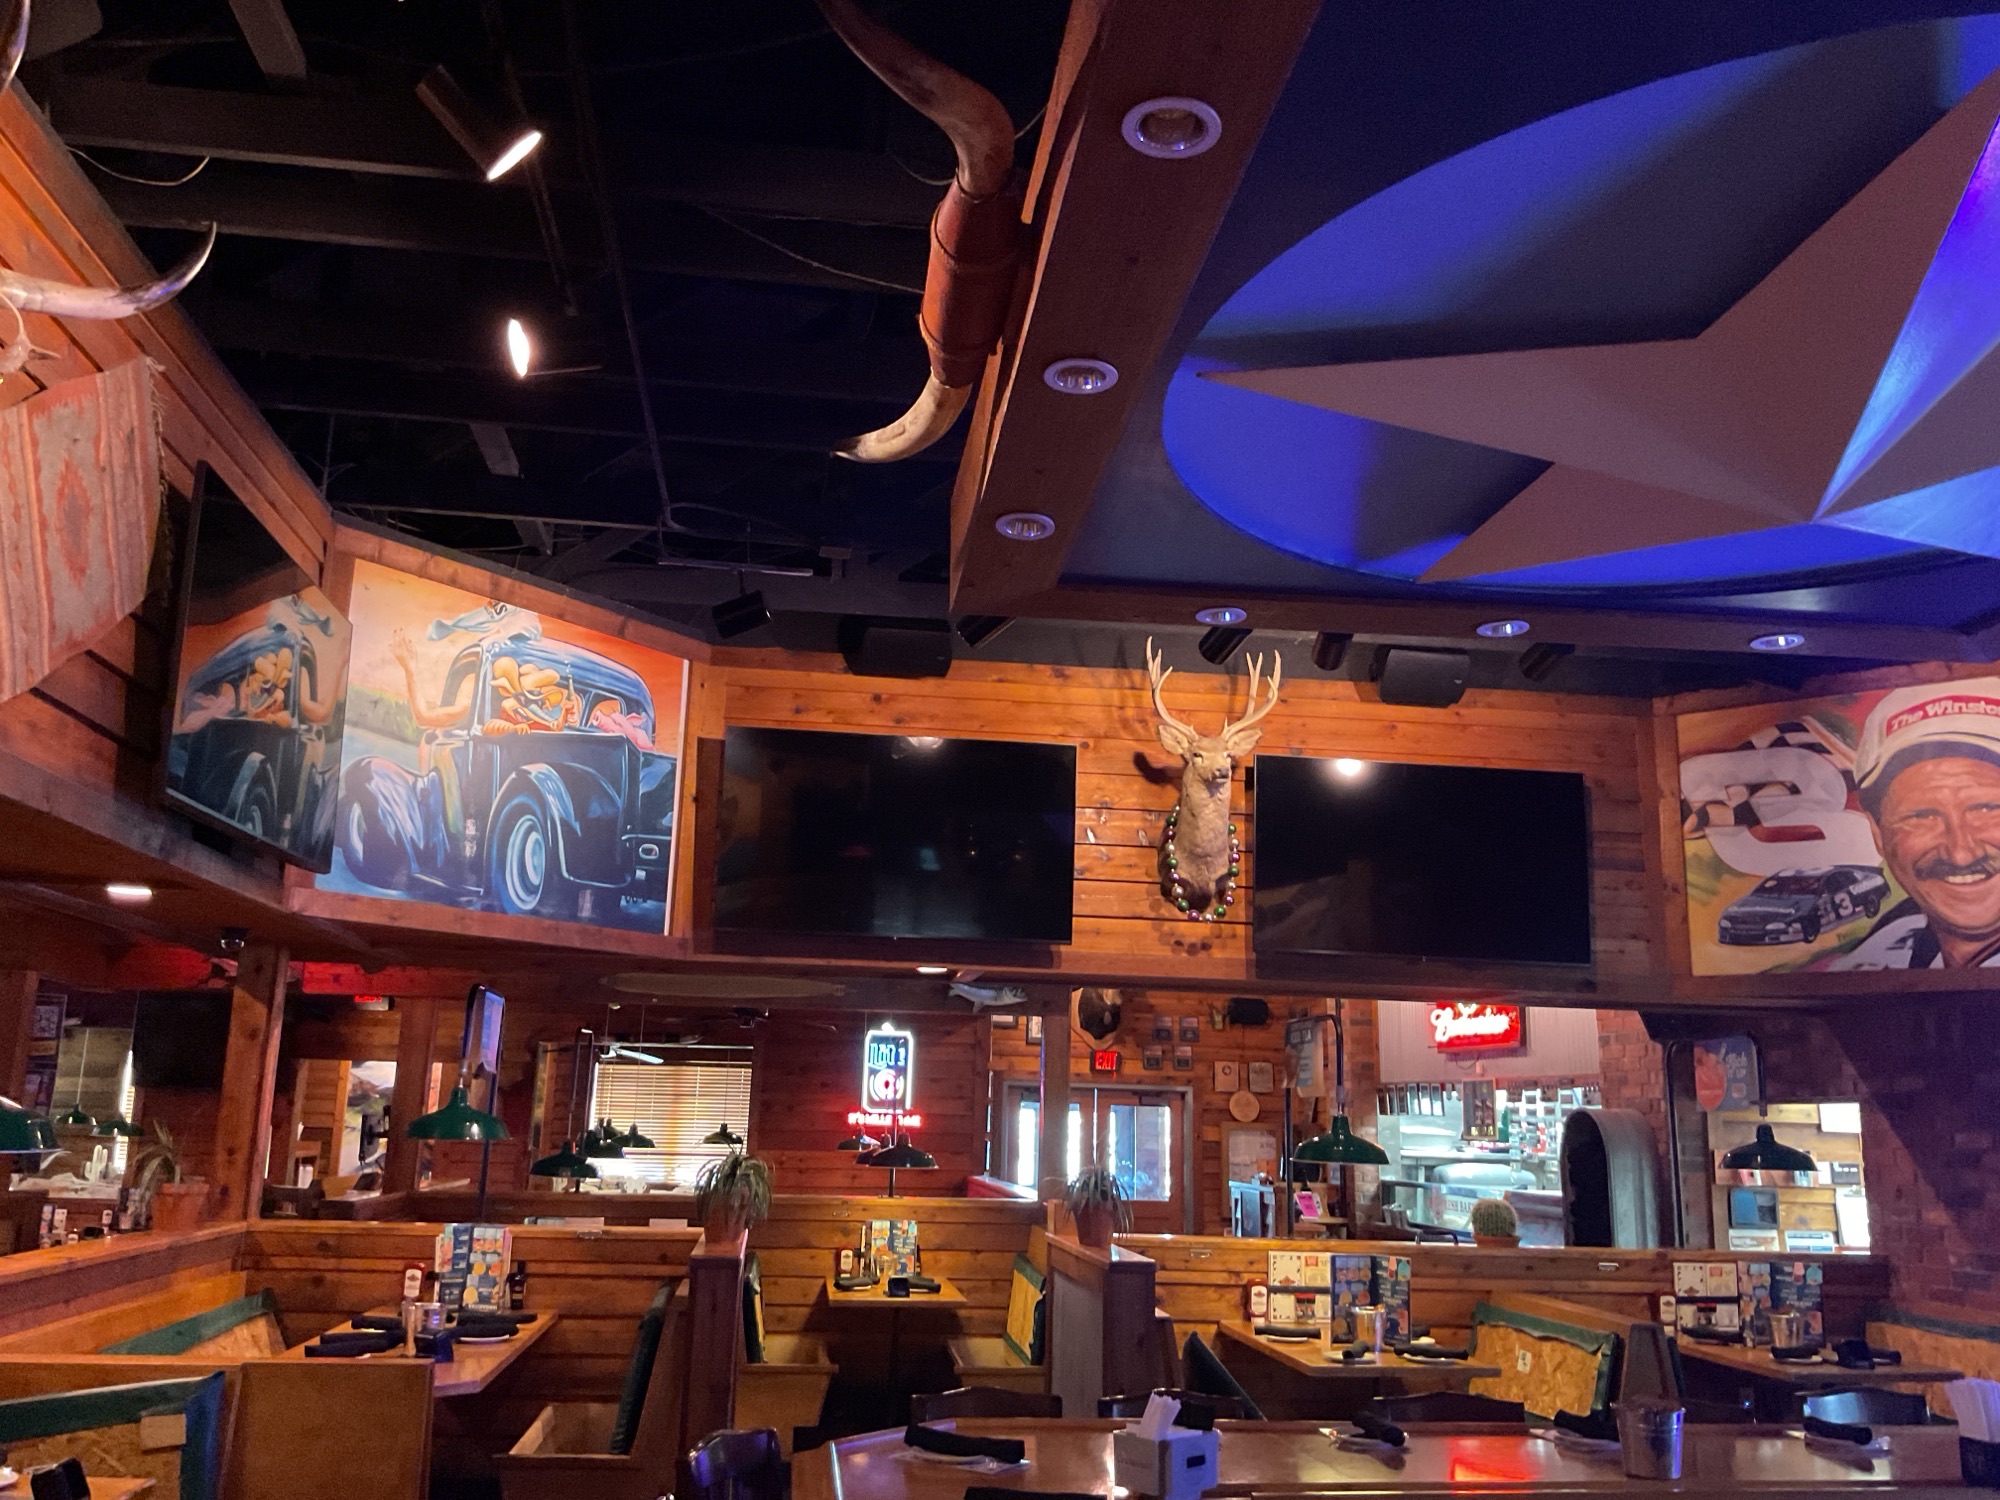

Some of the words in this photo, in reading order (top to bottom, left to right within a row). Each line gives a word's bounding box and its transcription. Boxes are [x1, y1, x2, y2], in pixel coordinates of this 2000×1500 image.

[1891, 711, 1924, 731] The
[1925, 700, 2000, 718] Winsto
[1834, 892, 1853, 917] 3
[1095, 1051, 1117, 1070] EXIT
